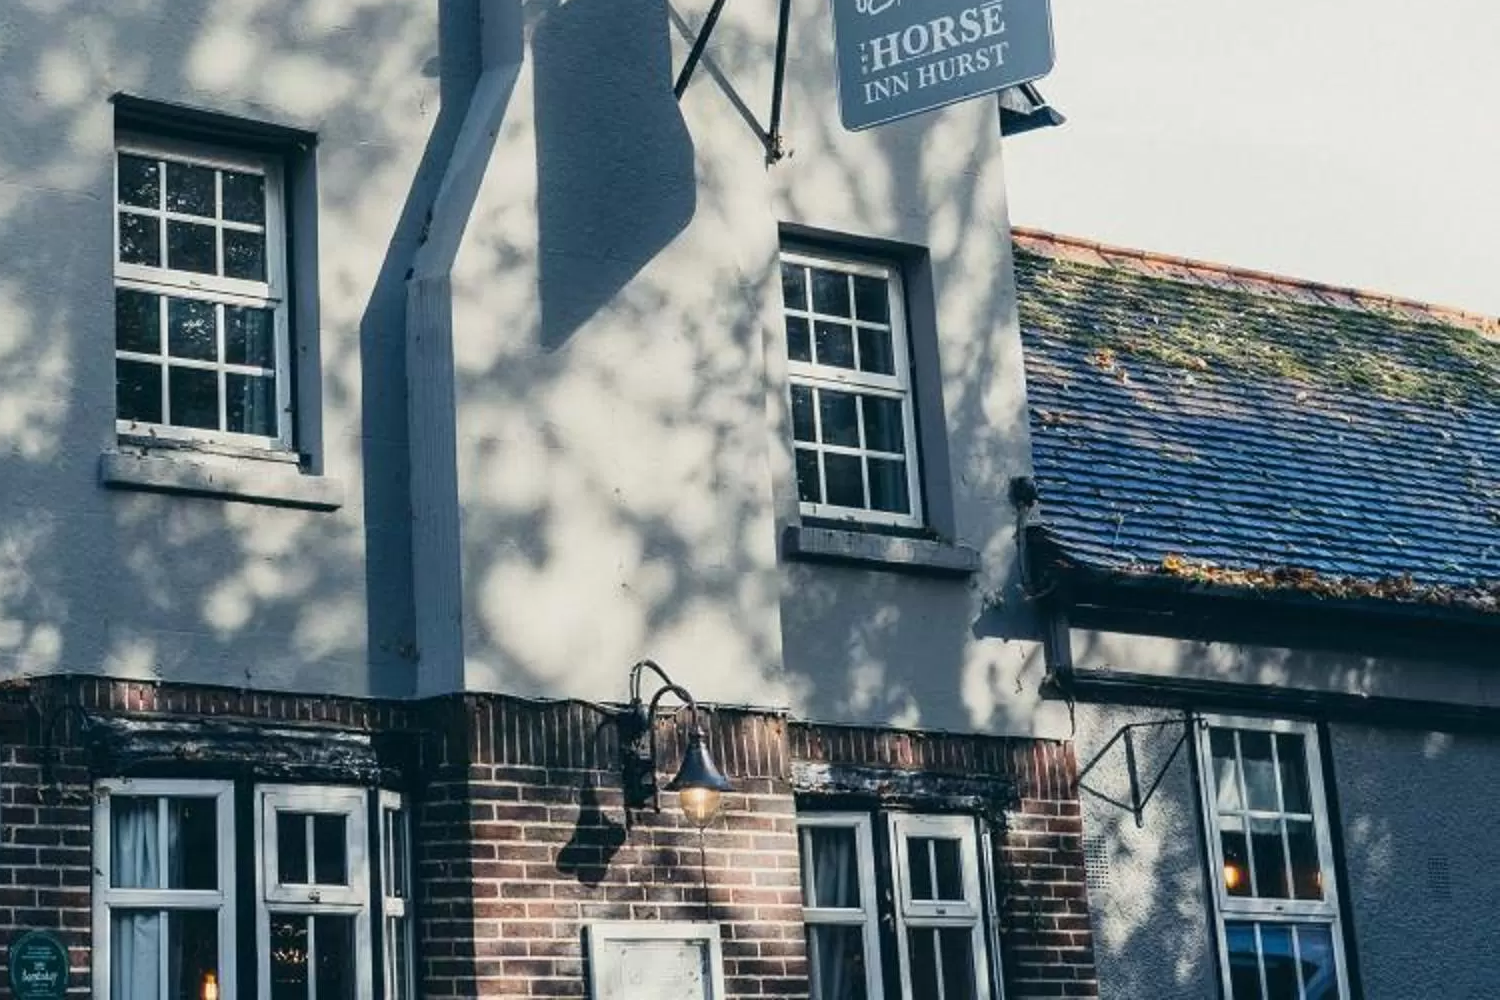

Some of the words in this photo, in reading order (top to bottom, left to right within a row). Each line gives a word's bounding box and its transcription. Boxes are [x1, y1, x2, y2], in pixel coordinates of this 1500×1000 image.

[870, 4, 1006, 72] HORSE
[864, 72, 909, 105] INN
[917, 41, 1010, 89] HURST
